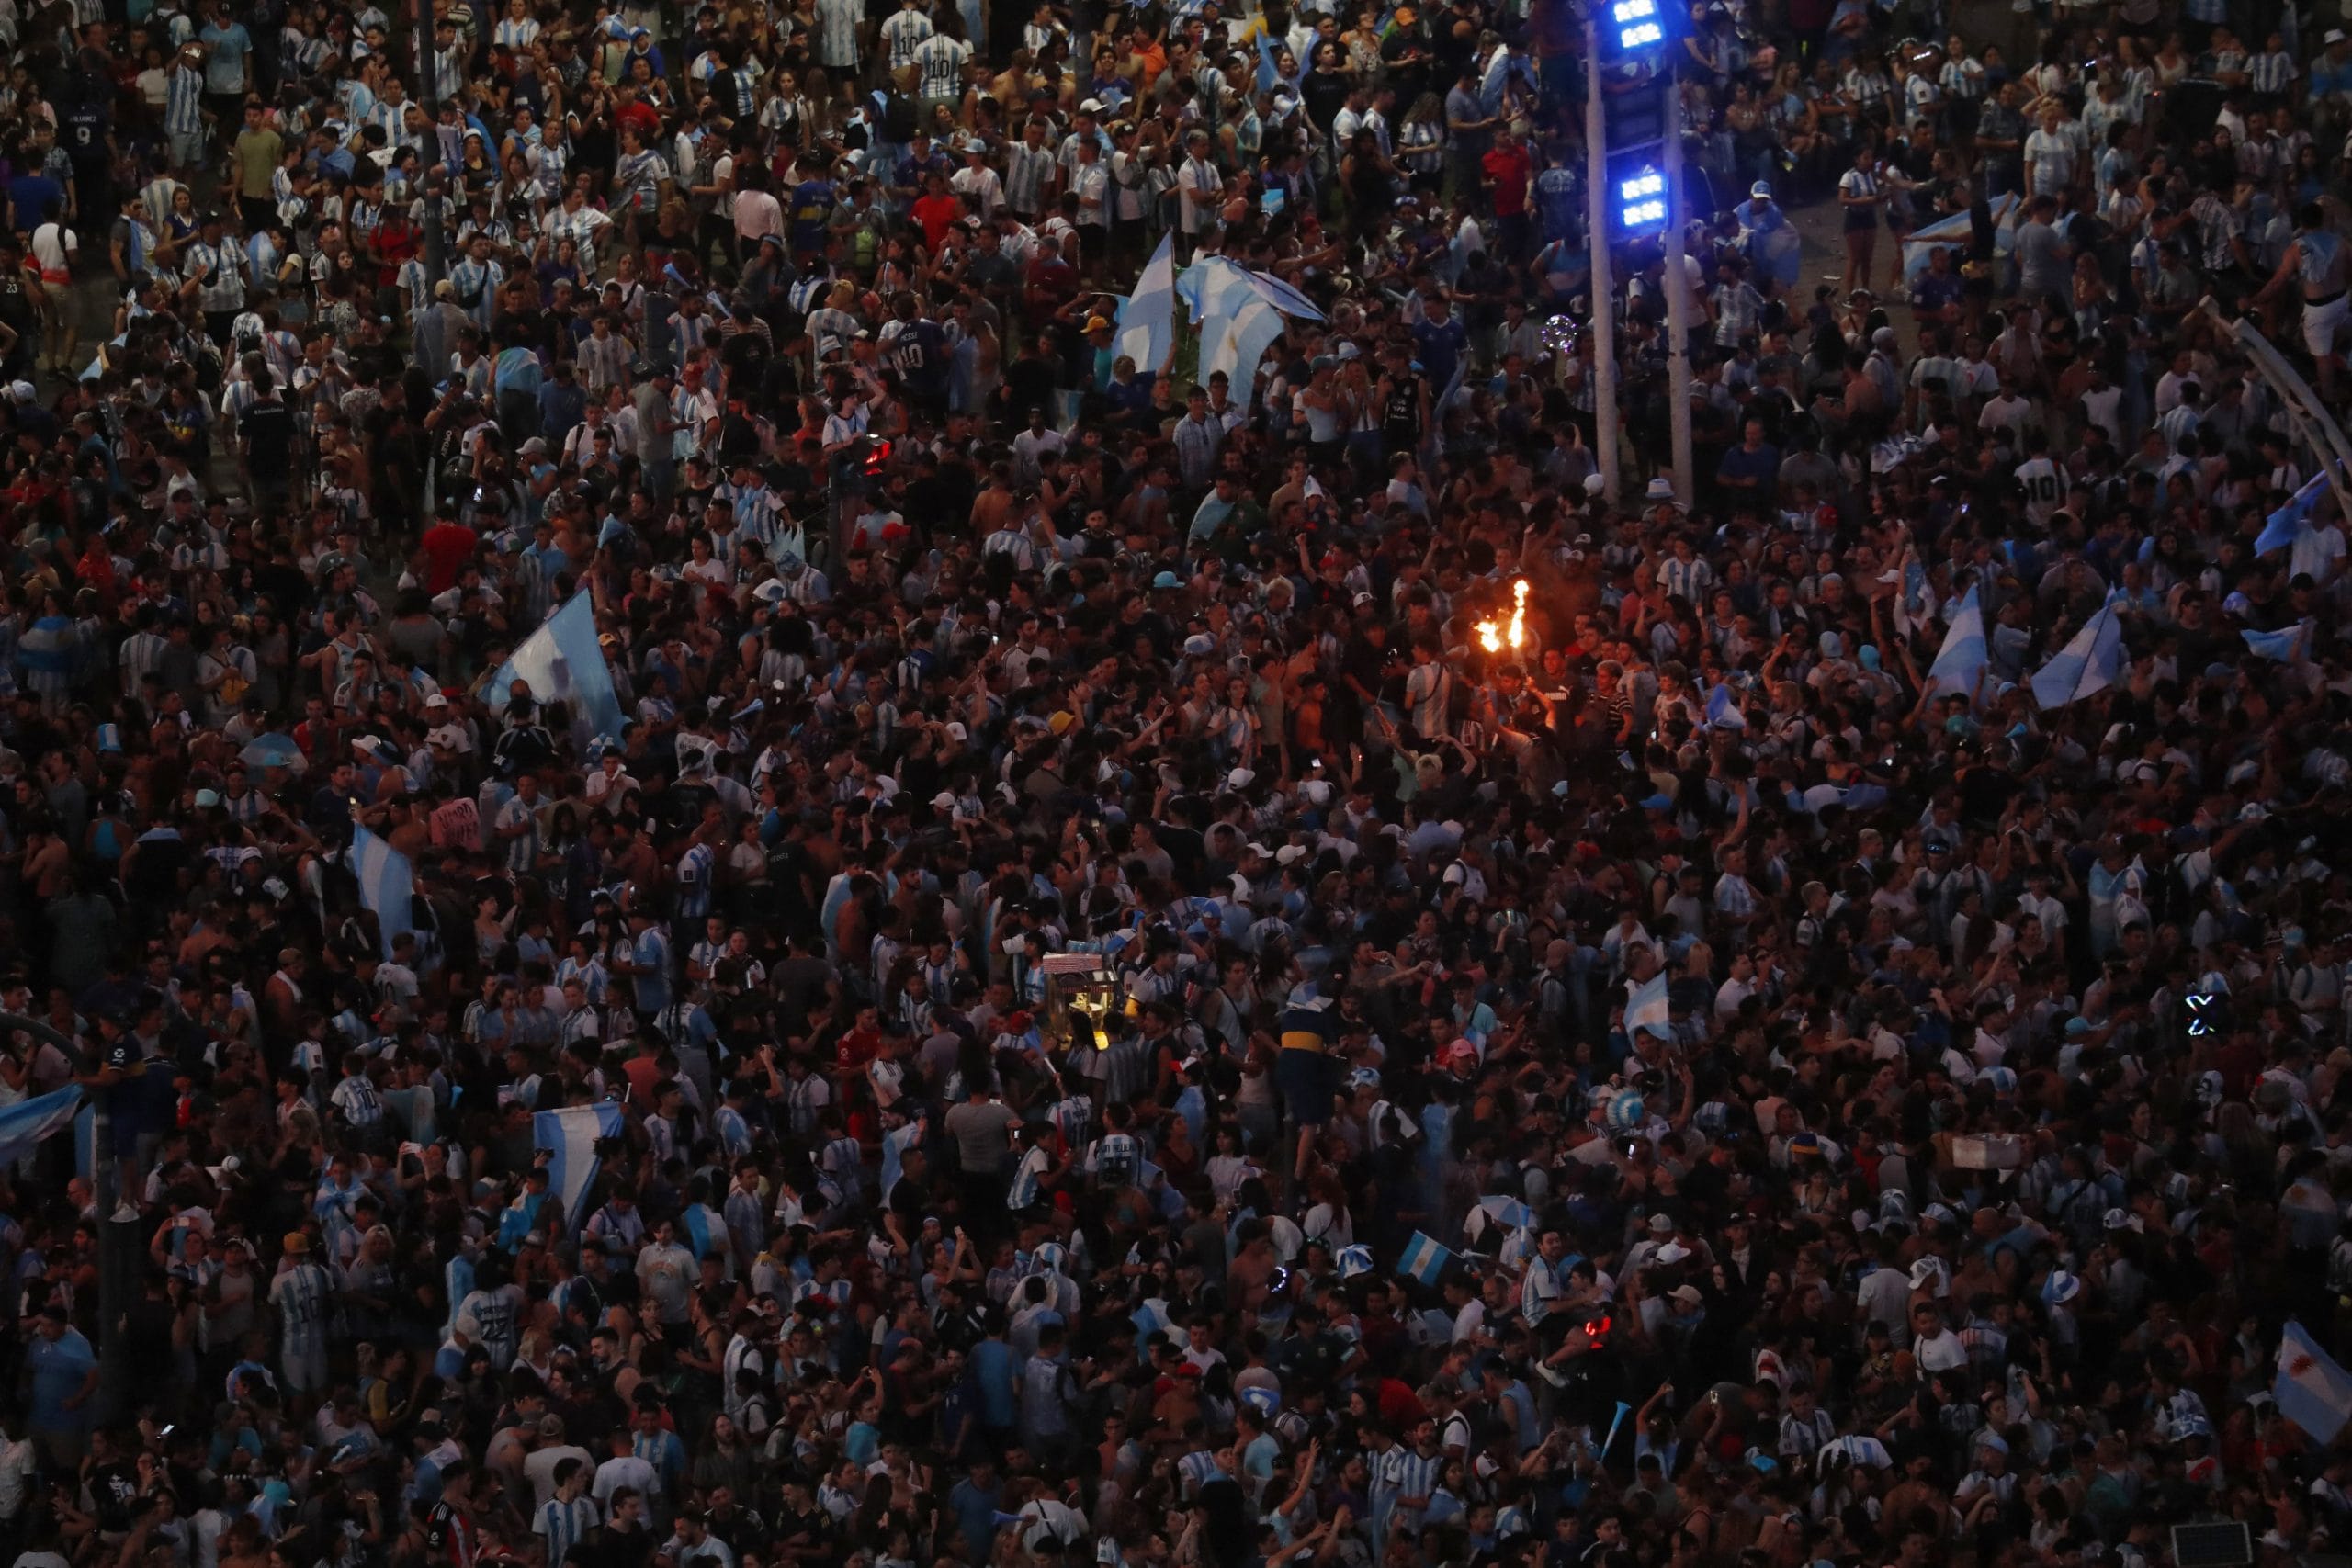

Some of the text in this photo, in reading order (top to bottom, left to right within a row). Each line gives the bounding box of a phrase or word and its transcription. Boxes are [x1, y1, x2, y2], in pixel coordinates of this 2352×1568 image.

[901, 36, 918, 55] 10
[931, 60, 949, 79] 10
[76, 126, 91, 147] 9
[6, 284, 17, 294] 23
[901, 343, 924, 368] 10
[2027, 476, 2056, 502] 10
[299, 1295, 319, 1323] 10
[480, 1317, 508, 1341] 22
